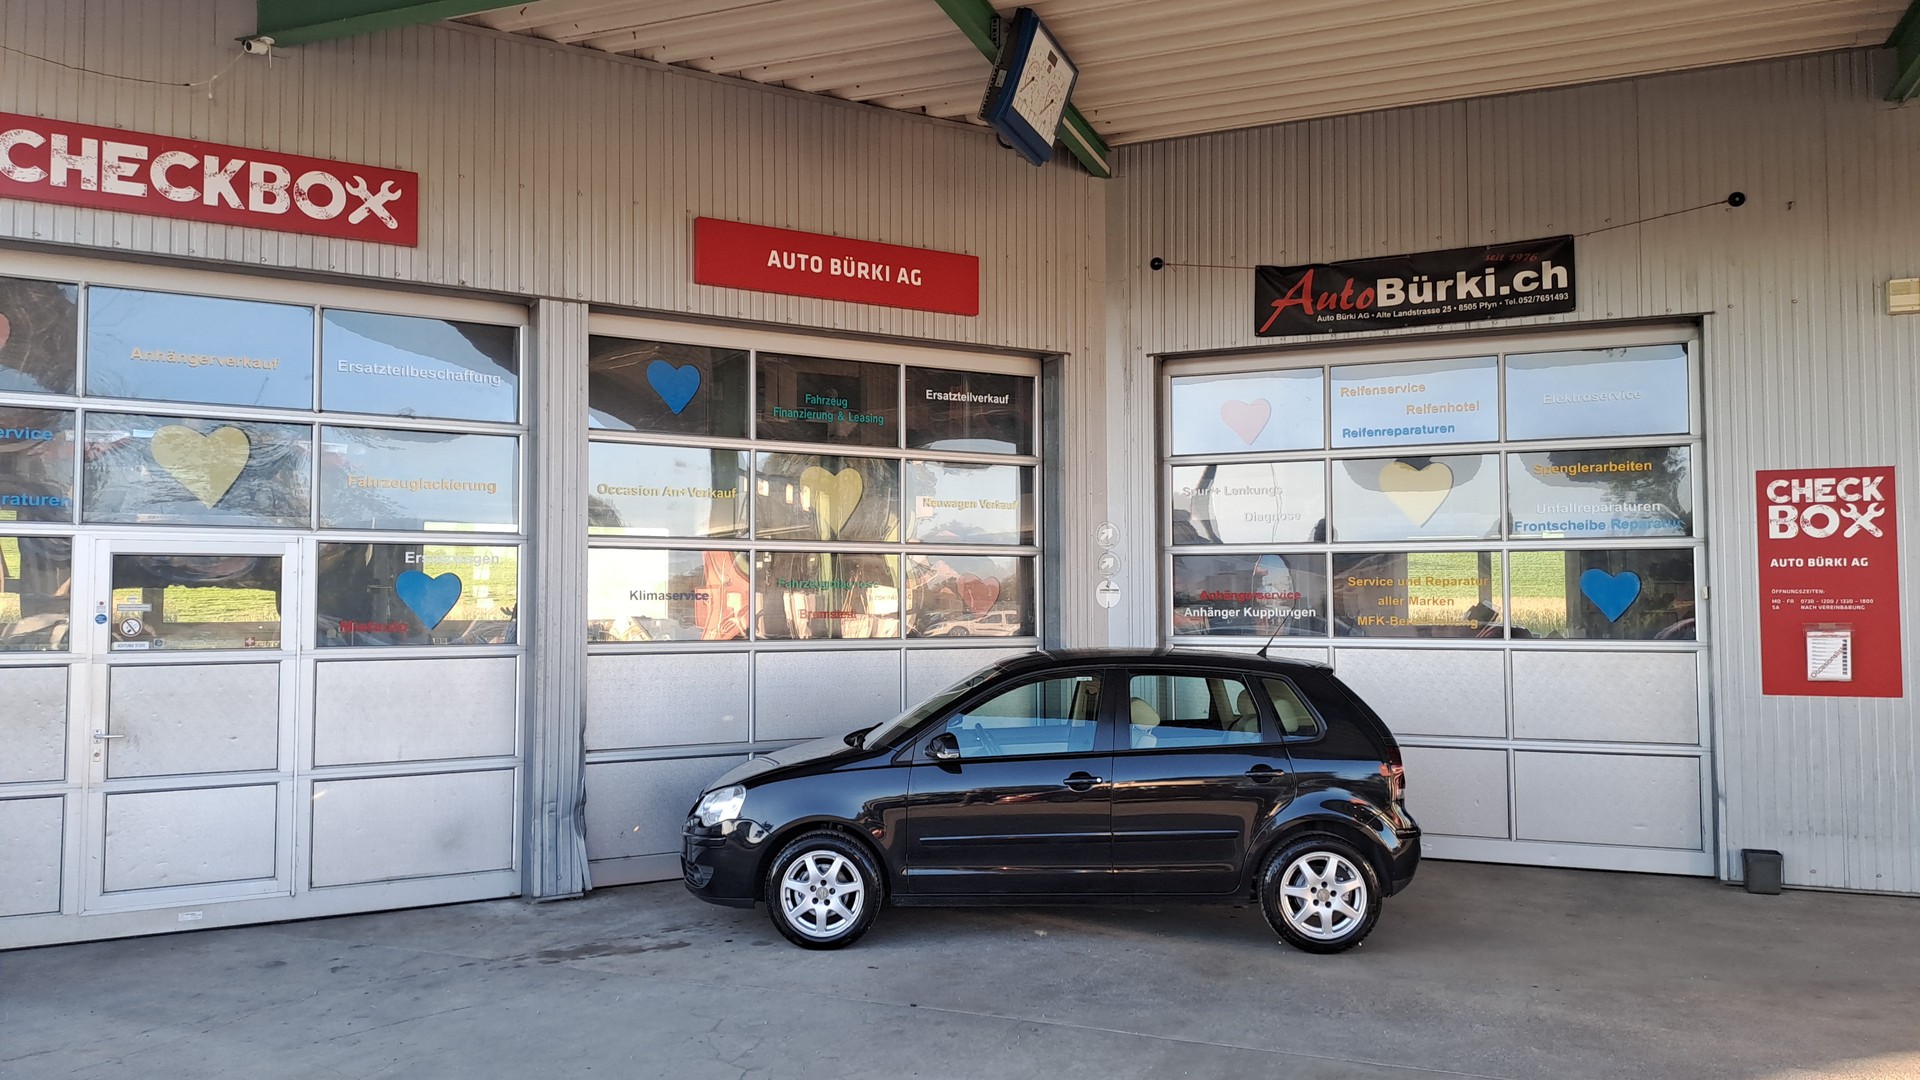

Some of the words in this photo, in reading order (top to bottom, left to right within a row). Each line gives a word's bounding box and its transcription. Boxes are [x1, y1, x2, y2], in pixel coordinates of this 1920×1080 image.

[0, 128, 402, 230] CHECKBOX
[1485, 253, 1504, 261] seit
[1508, 253, 1538, 262] 1976
[767, 249, 823, 274] AUTO
[829, 255, 891, 282] BÜRKI
[896, 267, 922, 286] AG
[1336, 313, 1356, 321] Bürki
[1393, 307, 1440, 318] Landstrasse
[1442, 305, 1452, 313] 25
[1458, 303, 1477, 311] 8505
[1480, 302, 1498, 311] Pfyn
[130, 347, 280, 370] Anhängerverkauf
[337, 359, 501, 387] Ersatzteilbeschaffung
[926, 389, 1010, 405] Ersatzteilverkauf
[1340, 383, 1426, 397] Reifenservice
[1543, 389, 1642, 405] Elektroservice
[805, 394, 848, 408] Fahrzeug
[1406, 401, 1480, 415] Reifenhotel
[773, 406, 834, 422] Finanzierung
[838, 413, 844, 421] &
[848, 412, 884, 425] Leasing
[1342, 424, 1455, 439] Reifenreparaturen
[1533, 461, 1652, 477] Spenglerarbeiten
[347, 475, 497, 494] Fahrzeuglackierung
[597, 483, 658, 497] Occasion
[1224, 485, 1283, 498] Lenkungs
[1766, 476, 1885, 503] CHECK
[922, 498, 977, 510] Neuwagen
[979, 499, 1018, 511] Verkauf
[1536, 502, 1661, 515] Unfallreparaturen
[1244, 512, 1301, 524] Diagnose
[1514, 519, 1606, 532] Frontscheibe
[1610, 518, 1683, 531] Reparatur
[1768, 503, 1885, 539] BOX
[1770, 558, 1804, 567] AUTO
[1807, 556, 1847, 567] BÜRKI
[1851, 557, 1869, 567] AG
[1348, 576, 1393, 586] Service
[1398, 576, 1421, 586] und
[1425, 576, 1489, 588] Reparatur
[629, 589, 710, 601] Klimaservice
[1200, 590, 1301, 602] Anhängerservice
[1378, 596, 1404, 606] aller
[1408, 596, 1455, 606] Marken
[1184, 607, 1240, 619] Anhänger
[1244, 607, 1316, 619] Kupplungen
